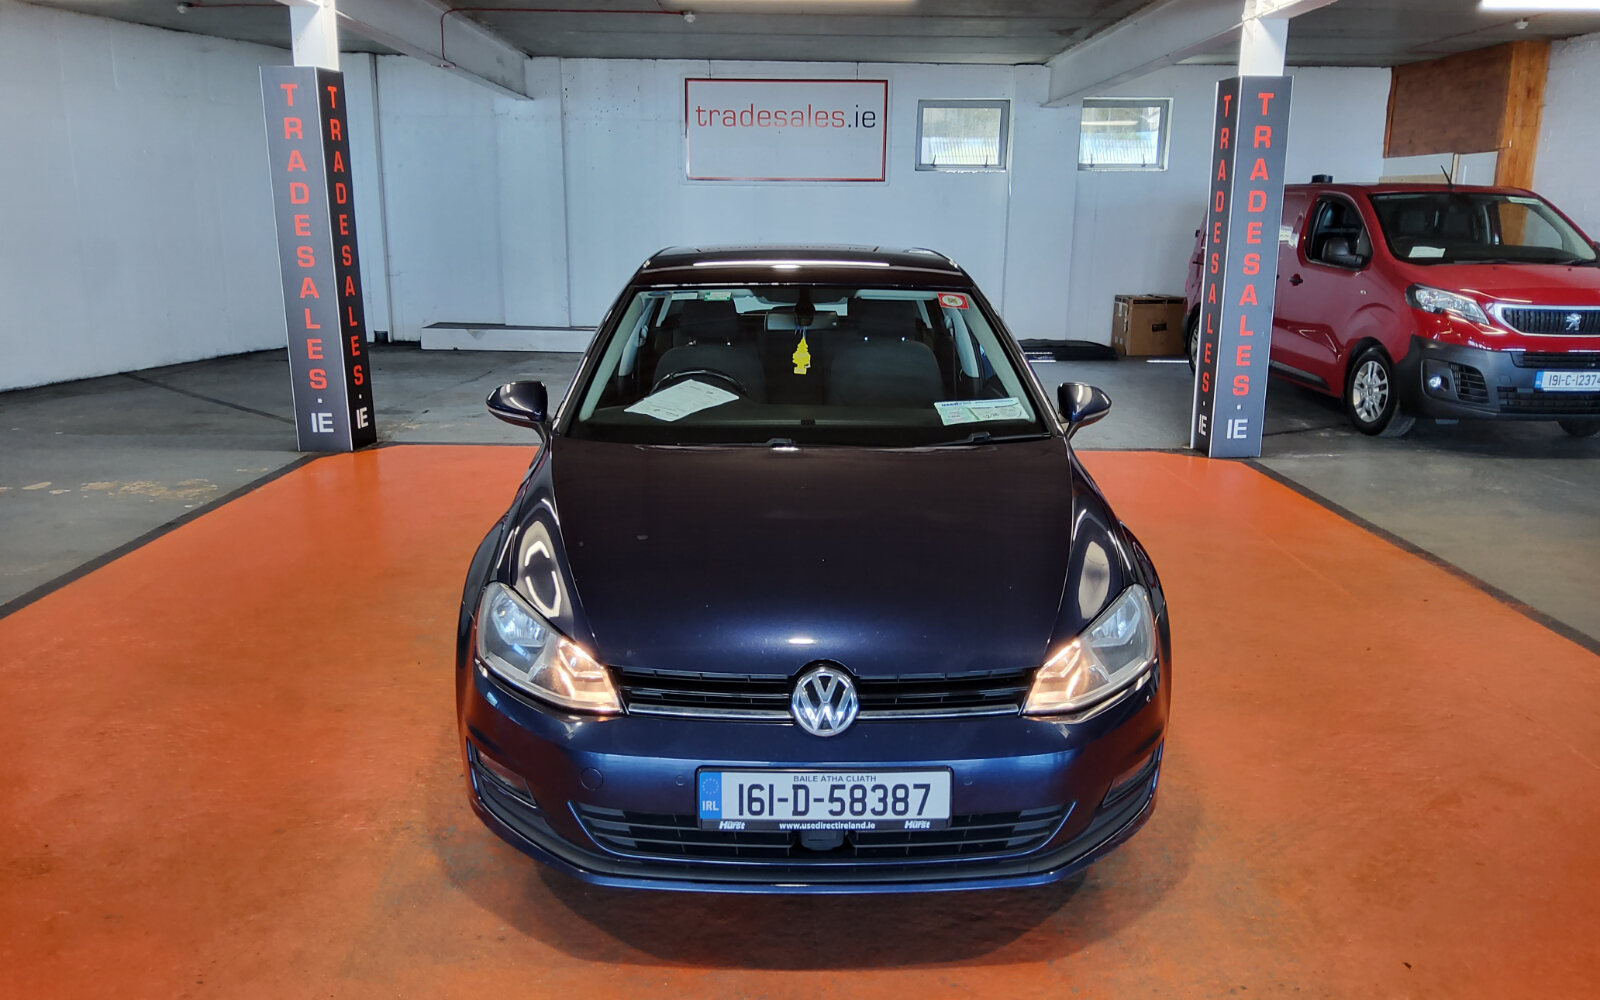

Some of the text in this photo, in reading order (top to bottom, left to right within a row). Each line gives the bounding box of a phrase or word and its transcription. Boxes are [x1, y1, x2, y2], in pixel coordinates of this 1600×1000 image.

[695, 103, 876, 128] tradesales.ie
[793, 775, 818, 783] BAILE
[846, 775, 876, 783] CLIATH
[702, 800, 720, 811] IRL
[738, 783, 931, 817] 161-D-58387
[779, 821, 876, 830] www.usedirectireland.ie
